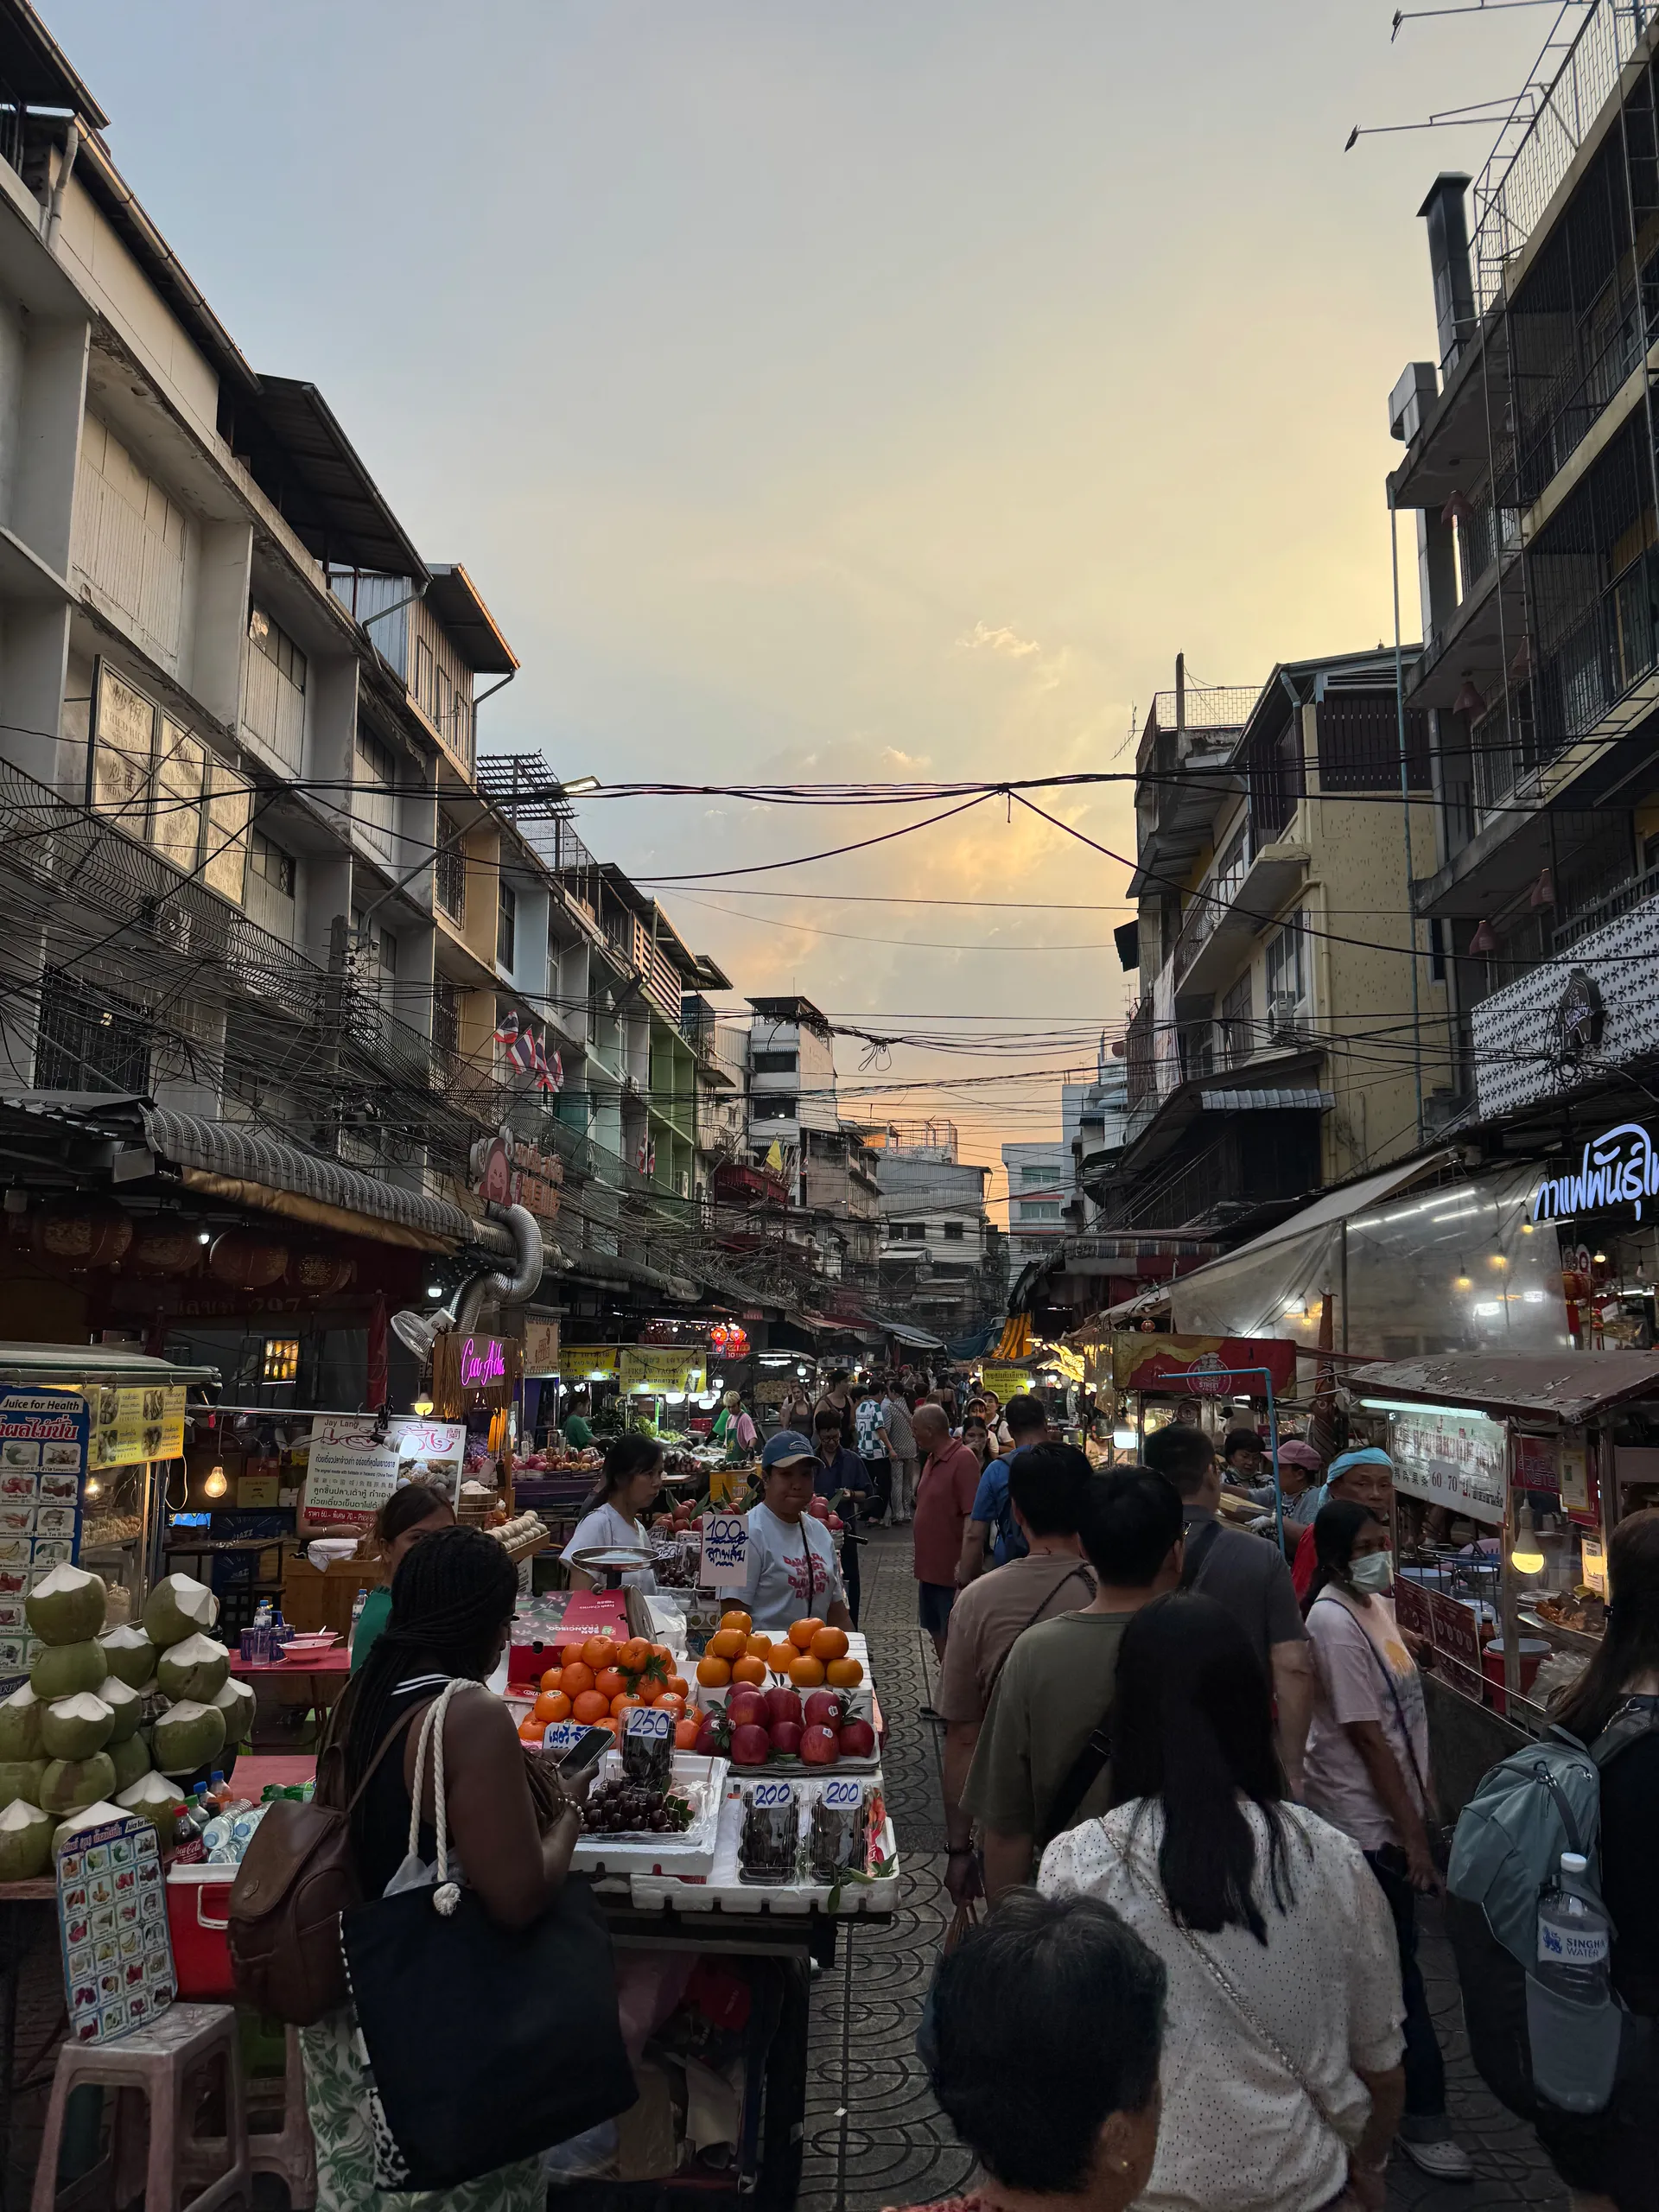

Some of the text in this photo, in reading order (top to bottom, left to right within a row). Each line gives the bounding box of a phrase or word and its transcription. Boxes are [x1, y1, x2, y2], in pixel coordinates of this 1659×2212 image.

[3, 1398, 79, 1411] Juice for Health
[325, 1419, 359, 1429] Jay Lang
[1432, 1471, 1442, 1488] 60
[1448, 1475, 1458, 1492] 70
[706, 1516, 741, 1539] 100
[630, 1709, 670, 1736] 250
[755, 1783, 791, 1805] 200
[826, 1782, 859, 1804] 200
[1567, 1937, 1606, 1949] SINGHA
[1567, 1947, 1599, 1957] WATER
